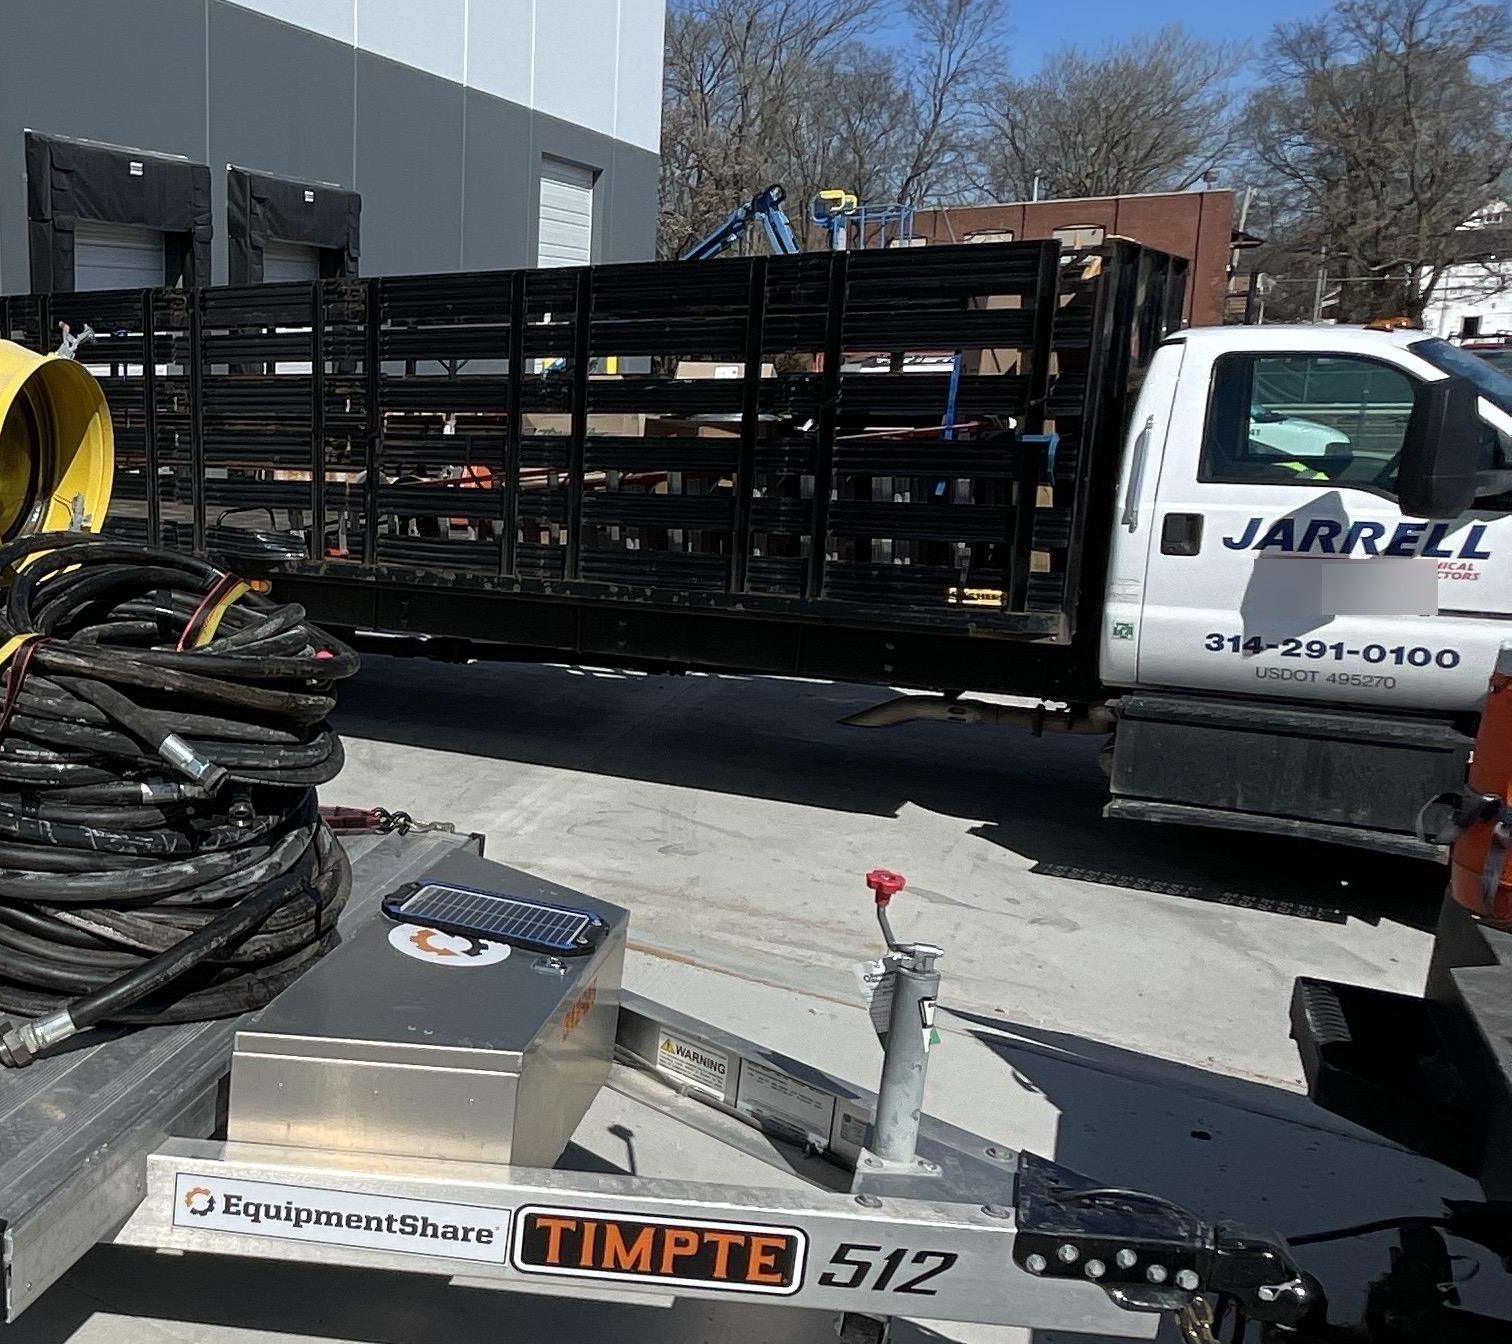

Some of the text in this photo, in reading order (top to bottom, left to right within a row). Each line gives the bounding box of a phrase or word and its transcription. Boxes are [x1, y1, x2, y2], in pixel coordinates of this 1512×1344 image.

[1222, 517, 1492, 560] JARRELL
[1204, 633, 1461, 669] 314-291-0100
[1255, 665, 1397, 690] USDOT 495270
[675, 1044, 726, 1075] WARNING
[221, 1192, 496, 1245] EquipmentShare
[537, 1216, 788, 1285] TIMPTE
[817, 1244, 960, 1297] 512
